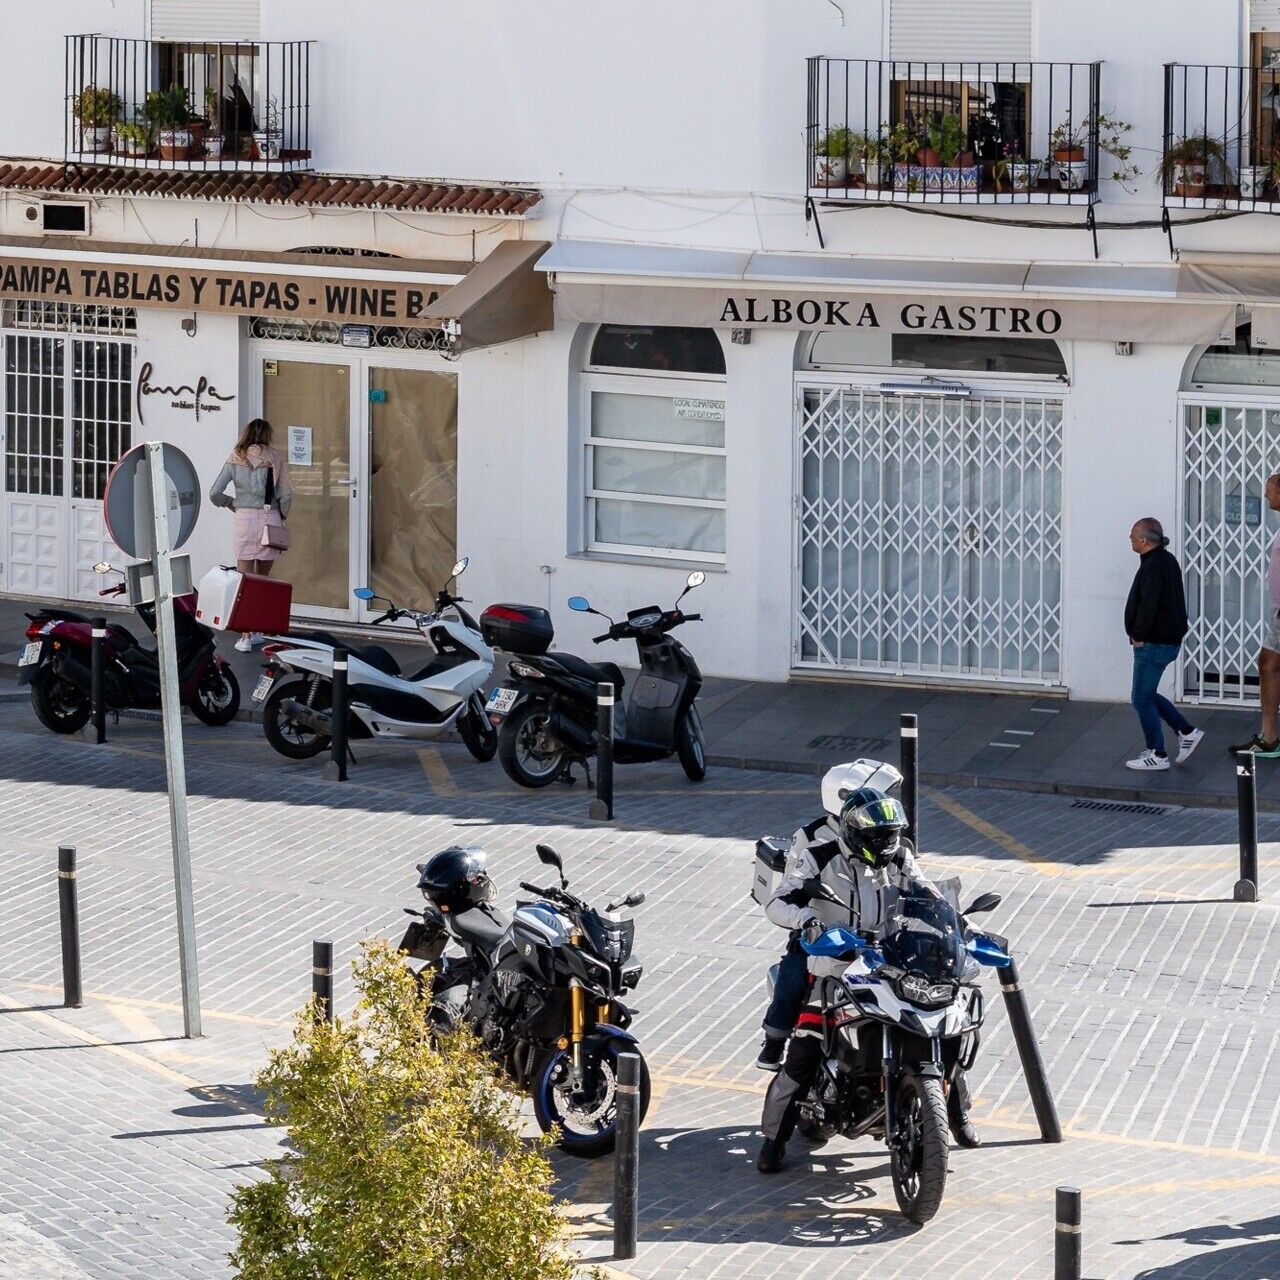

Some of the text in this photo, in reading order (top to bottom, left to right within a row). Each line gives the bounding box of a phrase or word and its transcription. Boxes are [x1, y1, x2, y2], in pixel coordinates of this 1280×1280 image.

[80, 269, 181, 303] TABLAS
[189, 276, 208, 304] Y
[215, 277, 300, 312] TAPAS
[325, 284, 397, 318] WINE
[719, 297, 1063, 335] ALBOKA GASTRO
[136, 361, 236, 426] Pampa
[171, 400, 222, 413] tablas tapas
[674, 399, 691, 408] LOCAL
